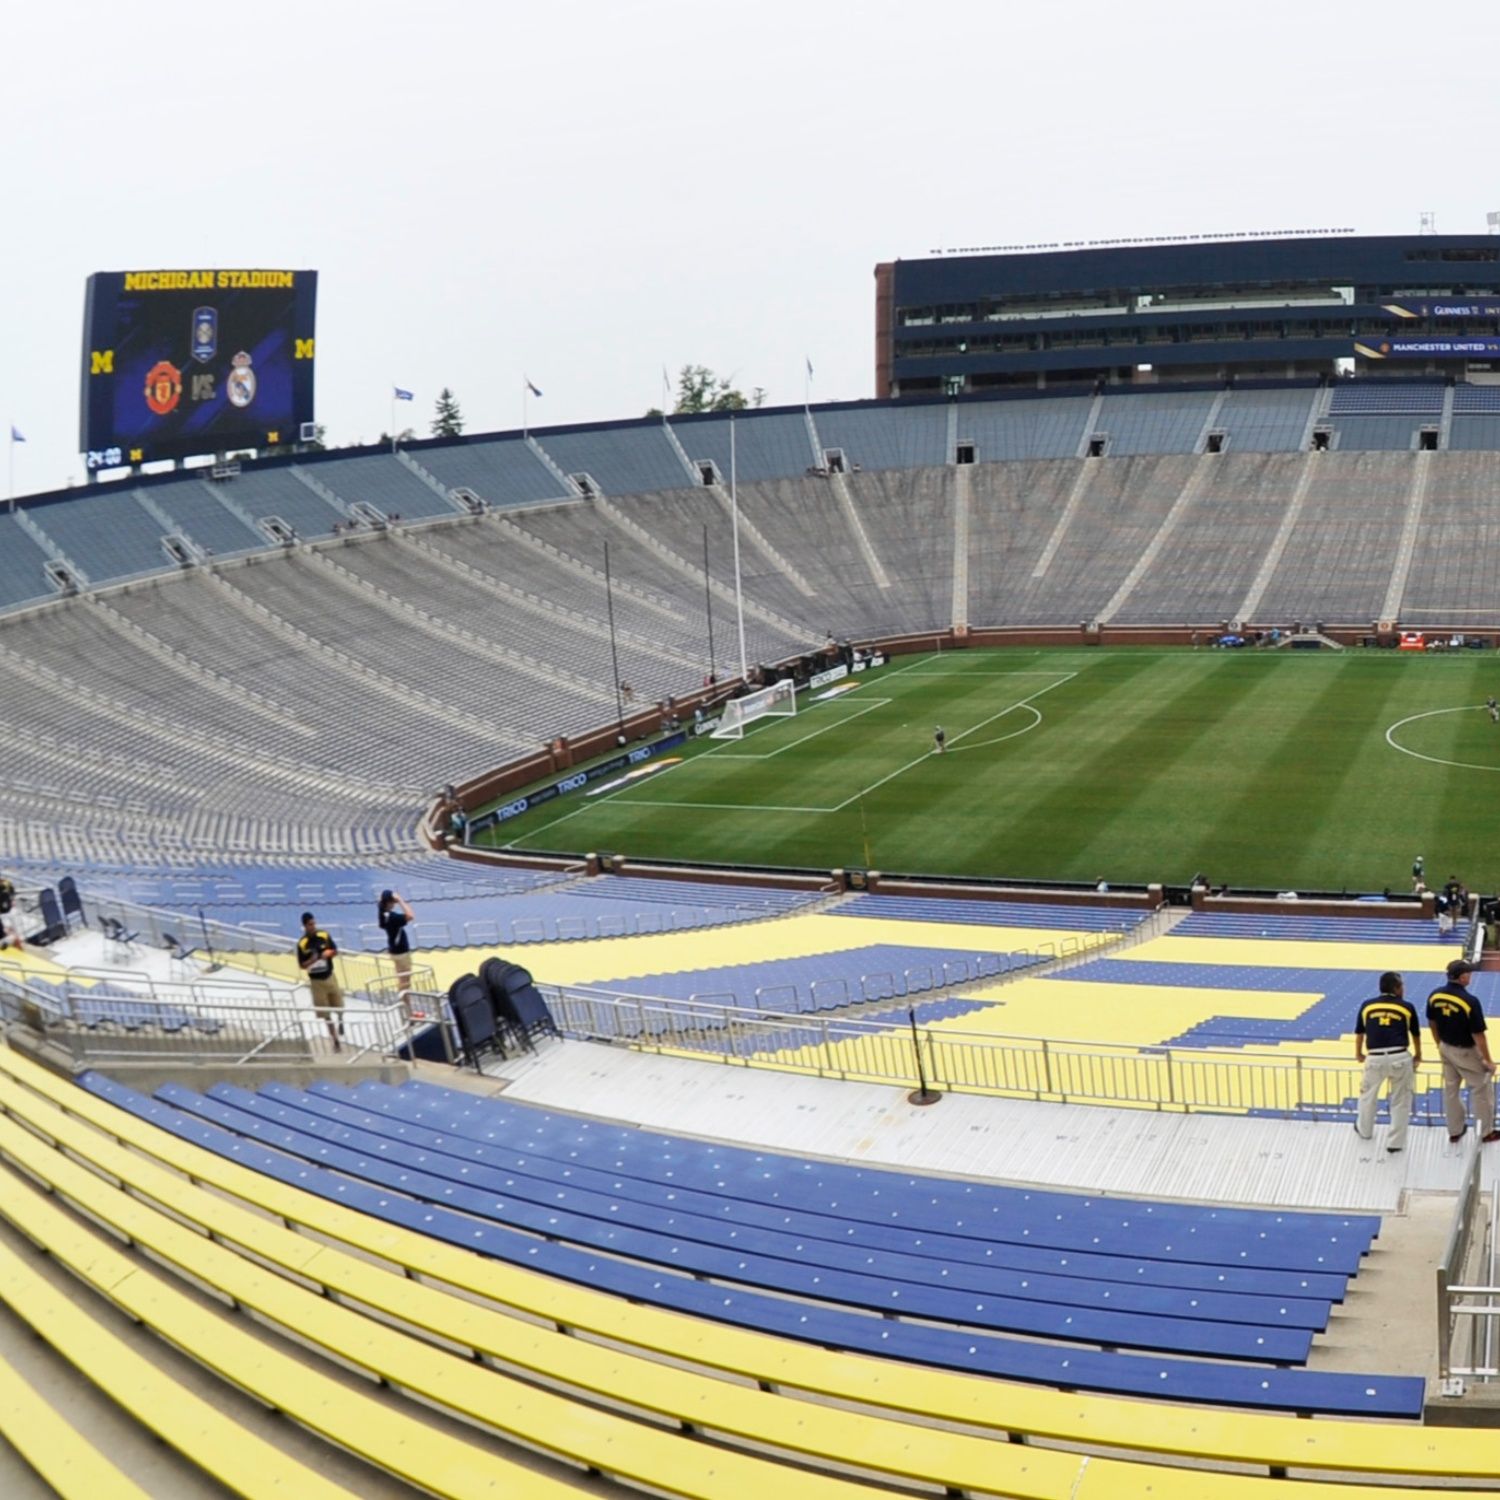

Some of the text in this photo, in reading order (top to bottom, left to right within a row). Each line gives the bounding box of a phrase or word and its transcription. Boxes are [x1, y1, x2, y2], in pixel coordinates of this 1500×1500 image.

[125, 271, 294, 291] MICHIGAN STADIUM
[296, 338, 316, 359] M
[1393, 342, 1451, 352] MANCHESTER
[1453, 342, 1485, 352] UNITED
[91, 350, 114, 374] M
[191, 374, 217, 400] VS.
[628, 746, 652, 764] TRICO
[557, 772, 588, 793] TRICO
[496, 798, 529, 822] TRICO
